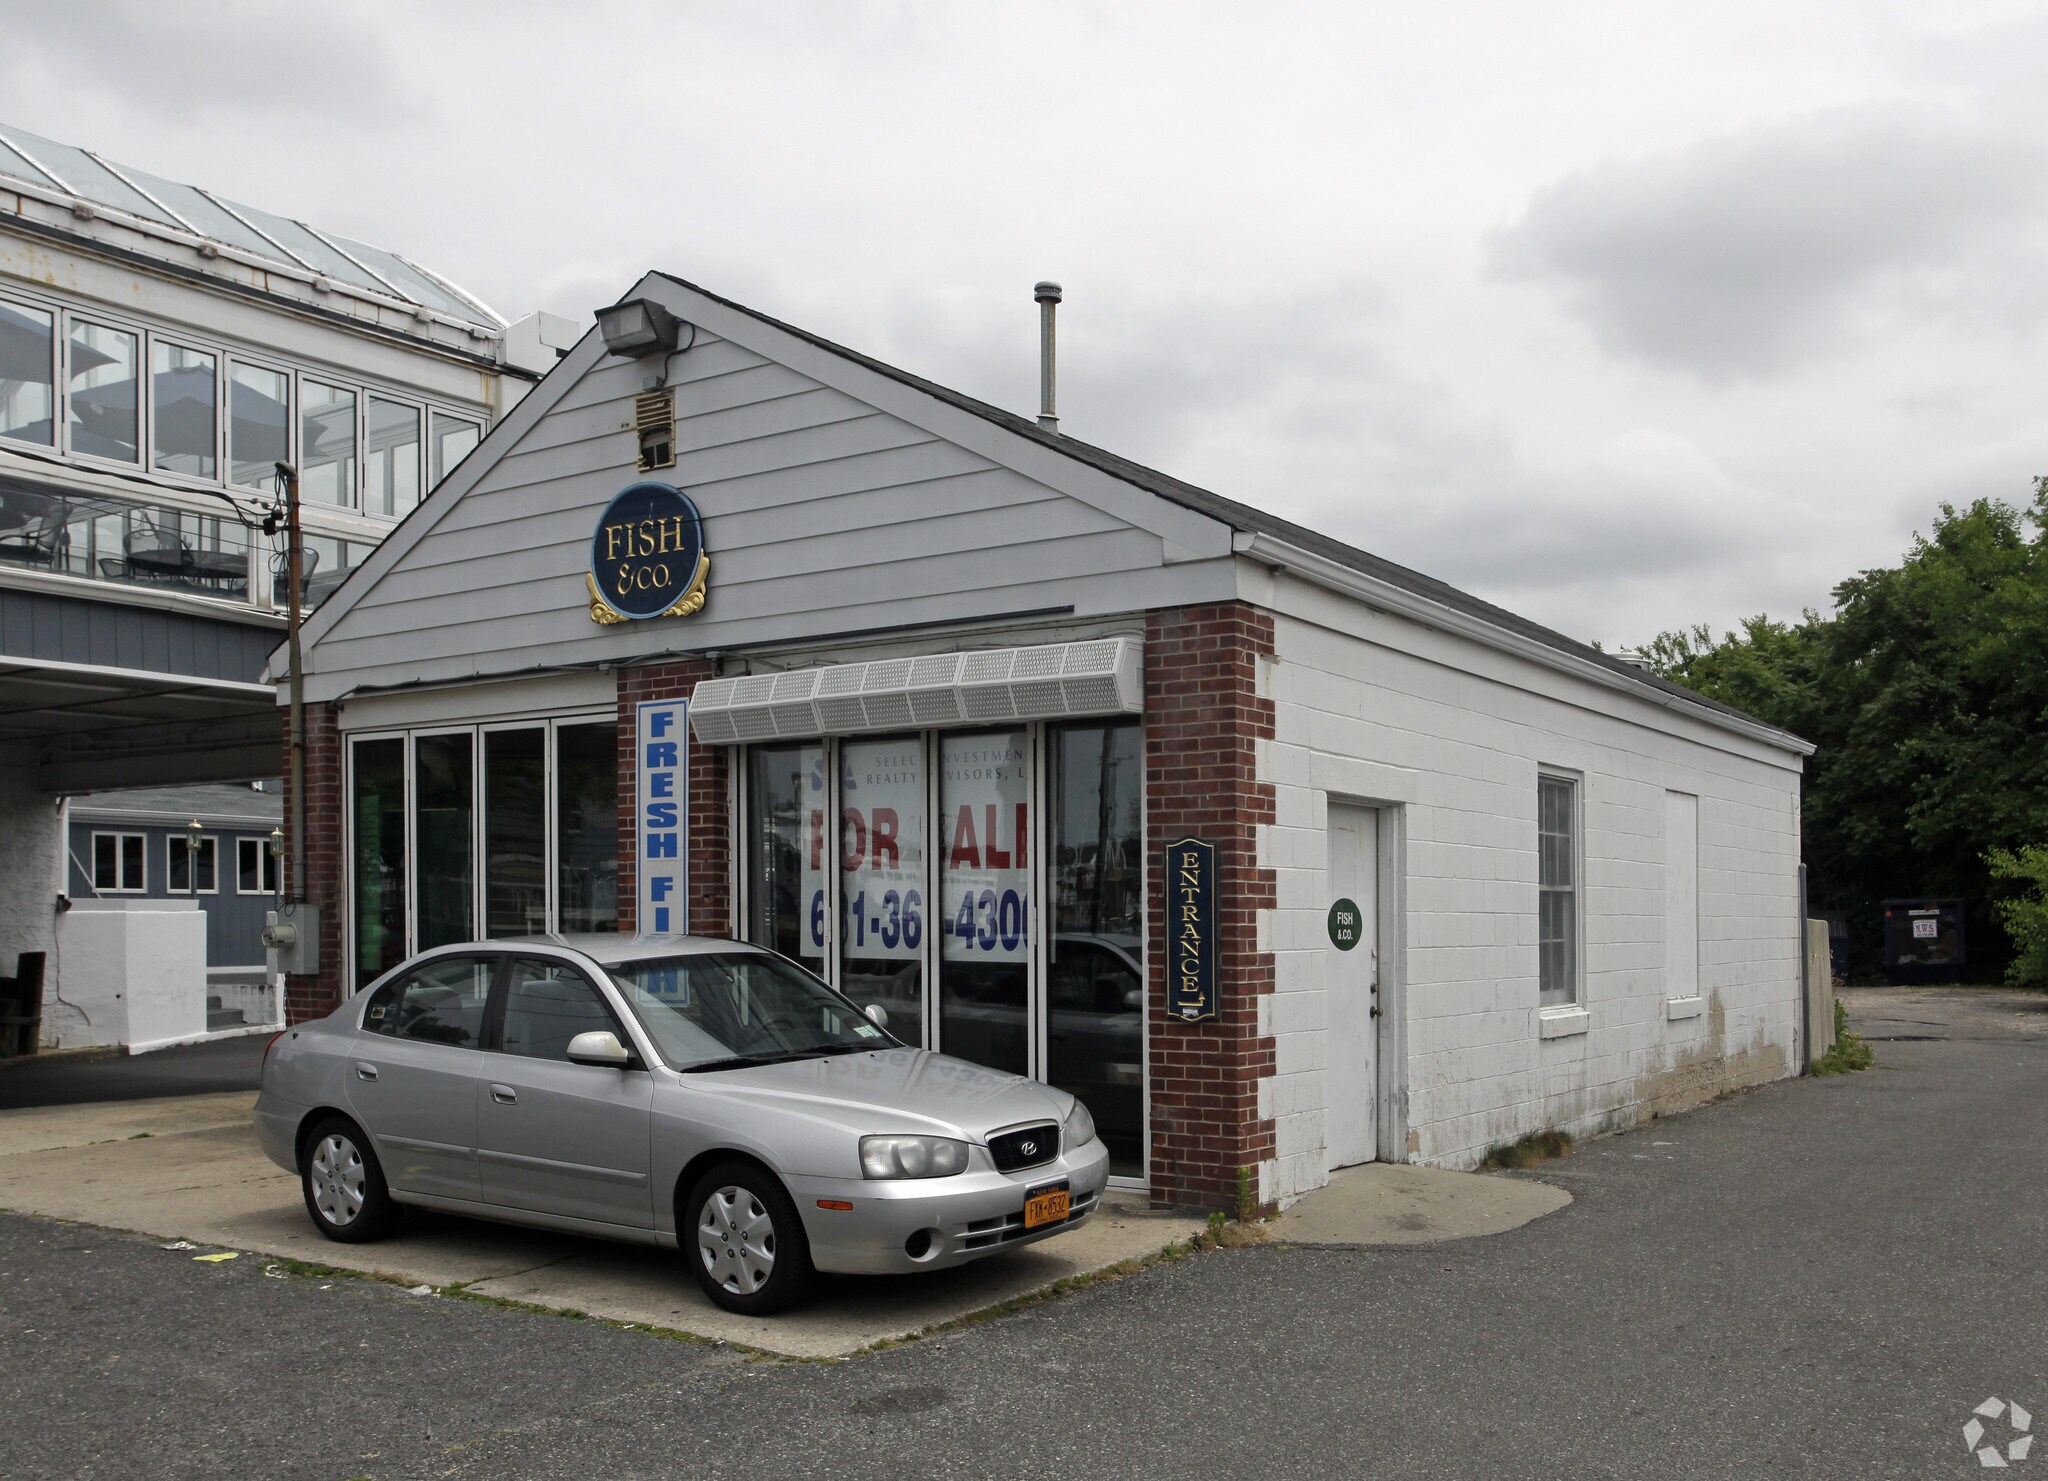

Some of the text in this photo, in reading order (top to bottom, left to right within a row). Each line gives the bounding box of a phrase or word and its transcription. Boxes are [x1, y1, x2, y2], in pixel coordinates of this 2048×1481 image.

[605, 515, 685, 561] FISH
[866, 772, 918, 785] REALTY
[946, 766, 1008, 781] VISORS,
[875, 749, 1024, 768] SELEC NVESTMEN
[646, 711, 678, 859] FRESH
[919, 803, 1028, 869] AL
[1179, 852, 1202, 993] ENTRANCE
[1336, 911, 1354, 926] FISH
